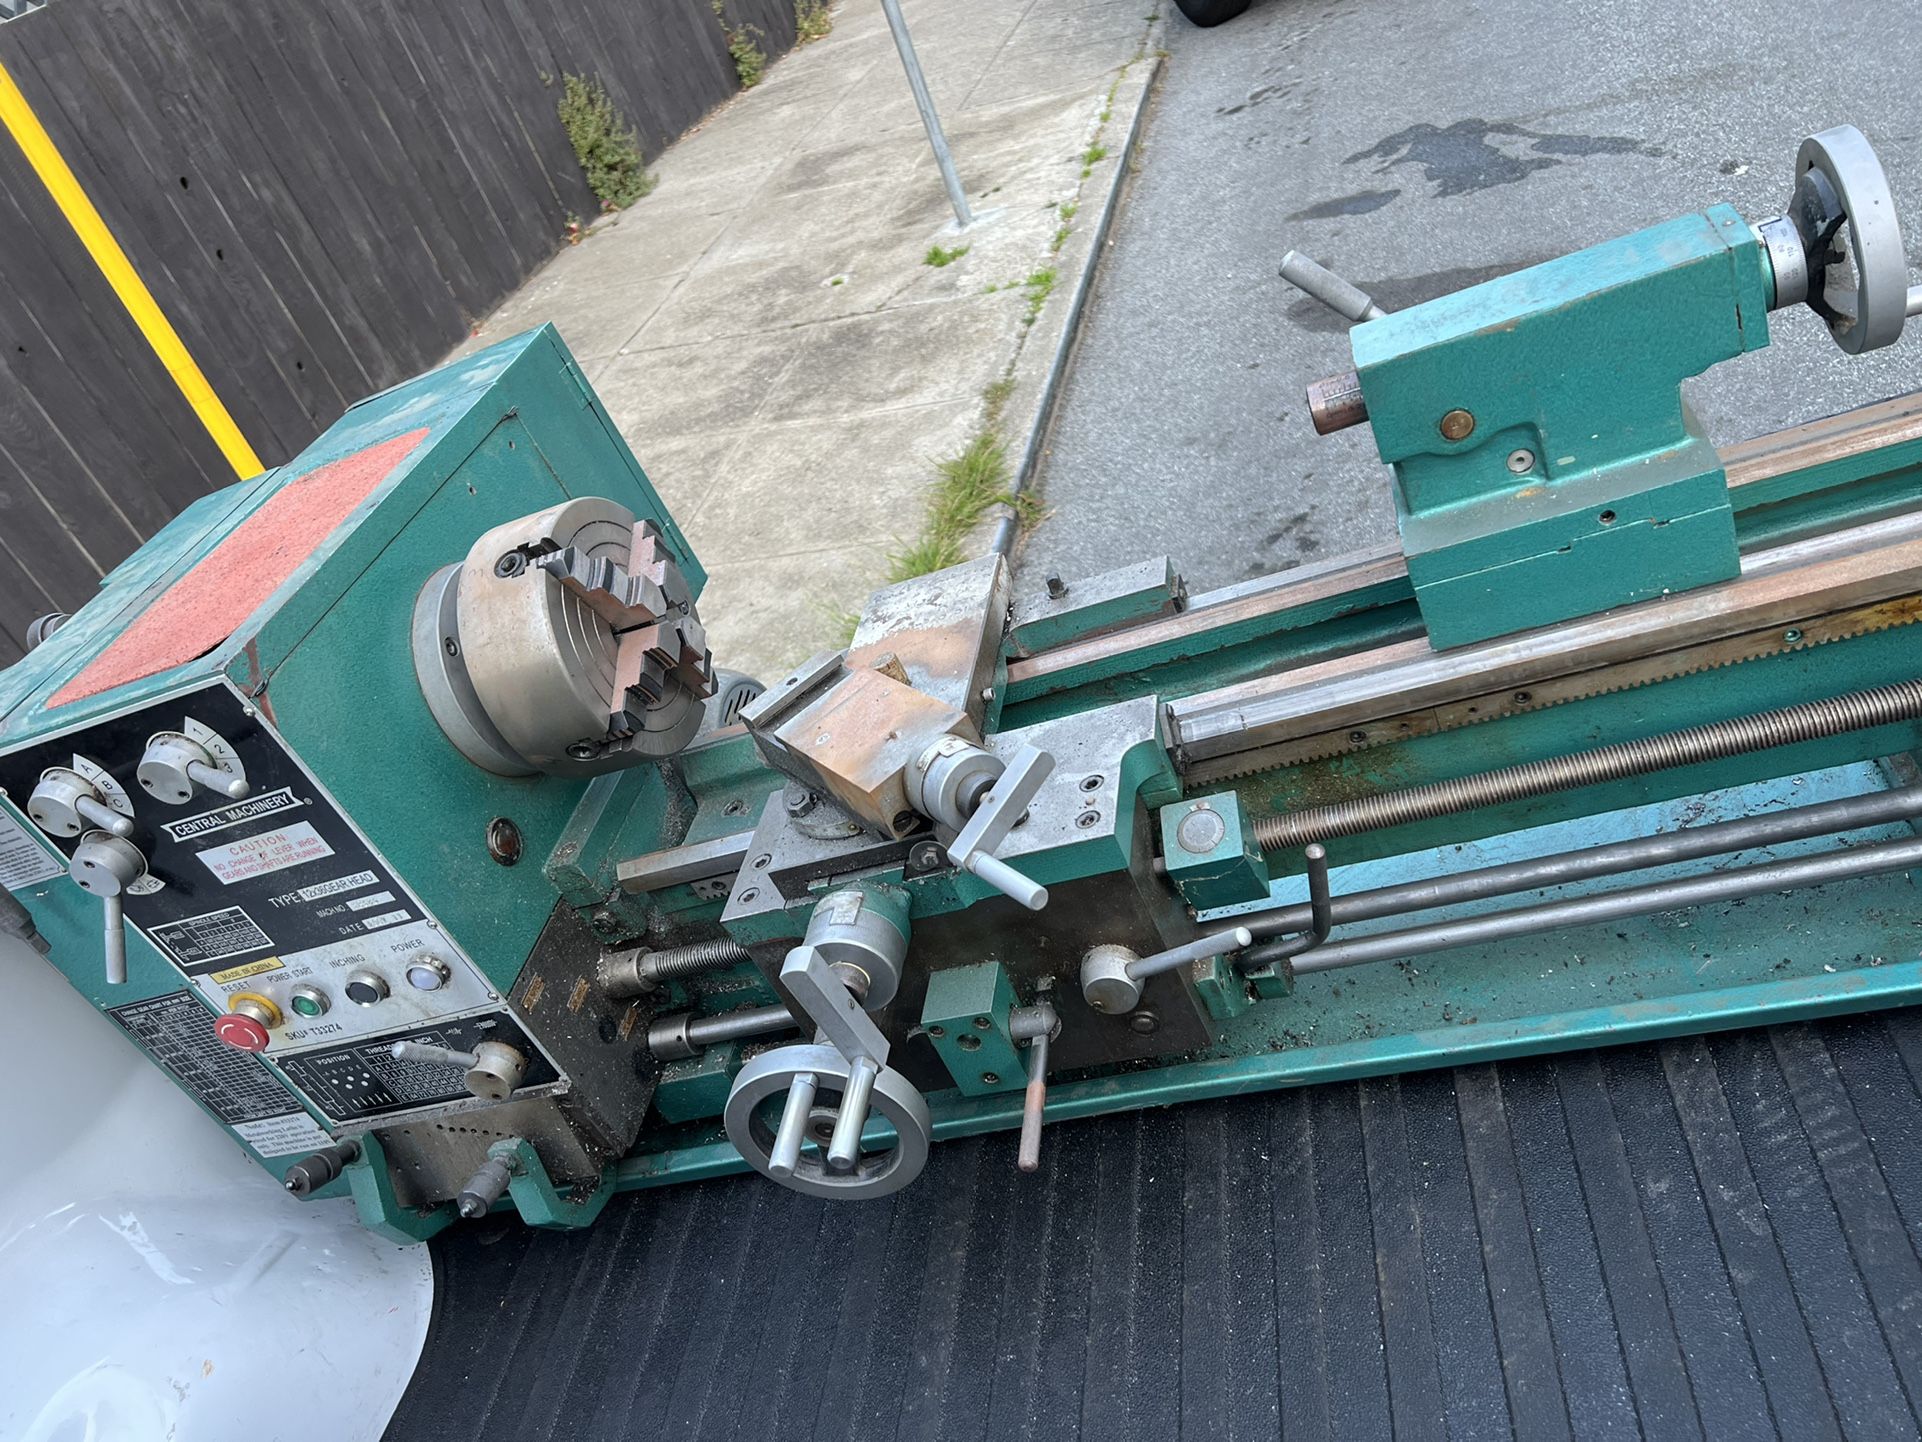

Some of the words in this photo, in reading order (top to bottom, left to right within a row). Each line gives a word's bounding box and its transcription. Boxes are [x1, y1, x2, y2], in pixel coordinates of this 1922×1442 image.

[192, 727, 203, 736] 1
[214, 744, 225, 754] 2
[81, 763, 92, 774] A
[223, 763, 233, 773] 3
[101, 780, 113, 790] B
[113, 799, 123, 809] C
[175, 814, 226, 836] CENTRAL
[225, 793, 290, 821] MACHINERY
[229, 833, 287, 856] CAUTION
[347, 872, 374, 887] HEAD
[391, 938, 424, 953] POWER
[329, 953, 365, 969] INCHING
[267, 972, 291, 983] POWER
[291, 966, 314, 978] START
[221, 980, 251, 993] RESET
[311, 1023, 343, 1036] T33274
[315, 1054, 351, 1066] POSITION
